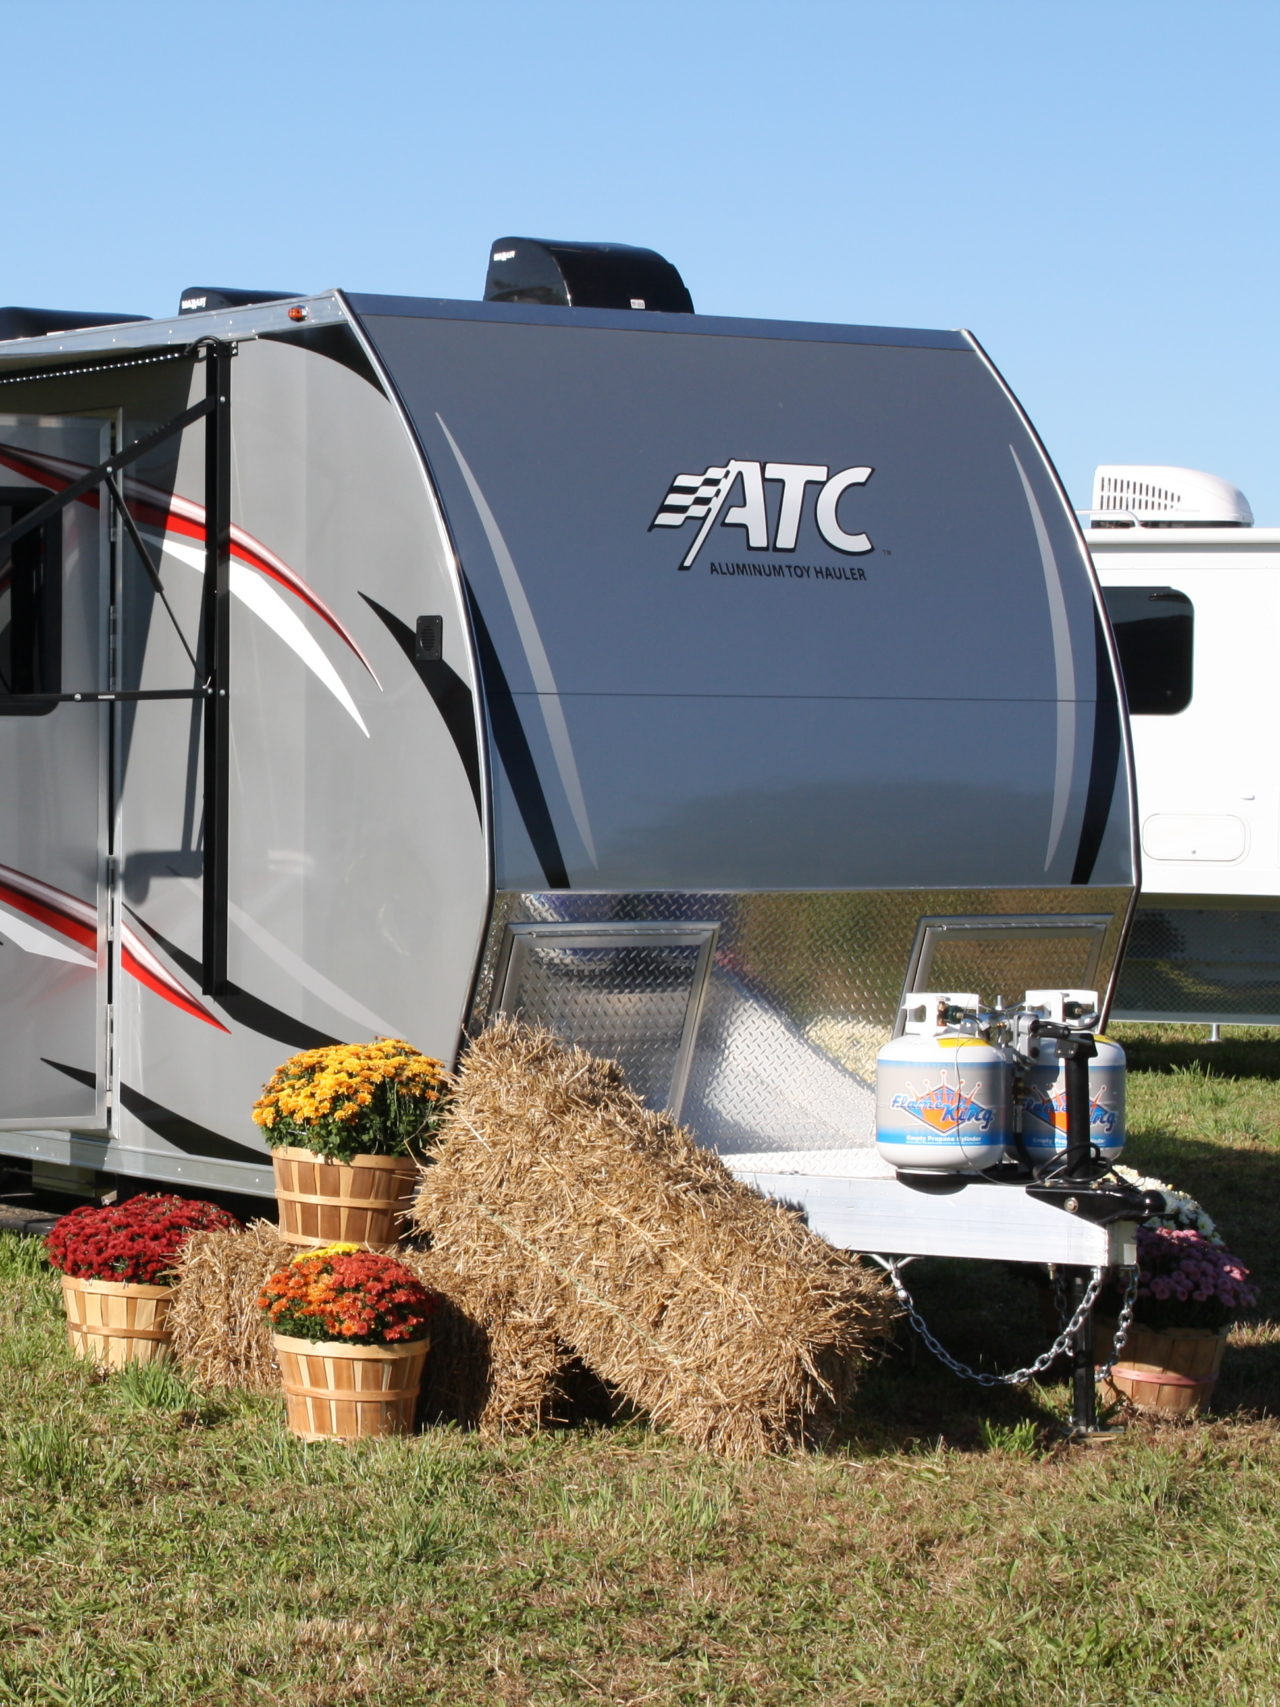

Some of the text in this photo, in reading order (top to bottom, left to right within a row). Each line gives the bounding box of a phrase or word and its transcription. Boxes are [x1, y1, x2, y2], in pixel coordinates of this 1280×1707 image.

[677, 458, 877, 571] ATC
[709, 561, 867, 582] ALUMINUM TOY HAULER
[891, 1094, 945, 1110] Flame
[941, 1103, 993, 1130] King
